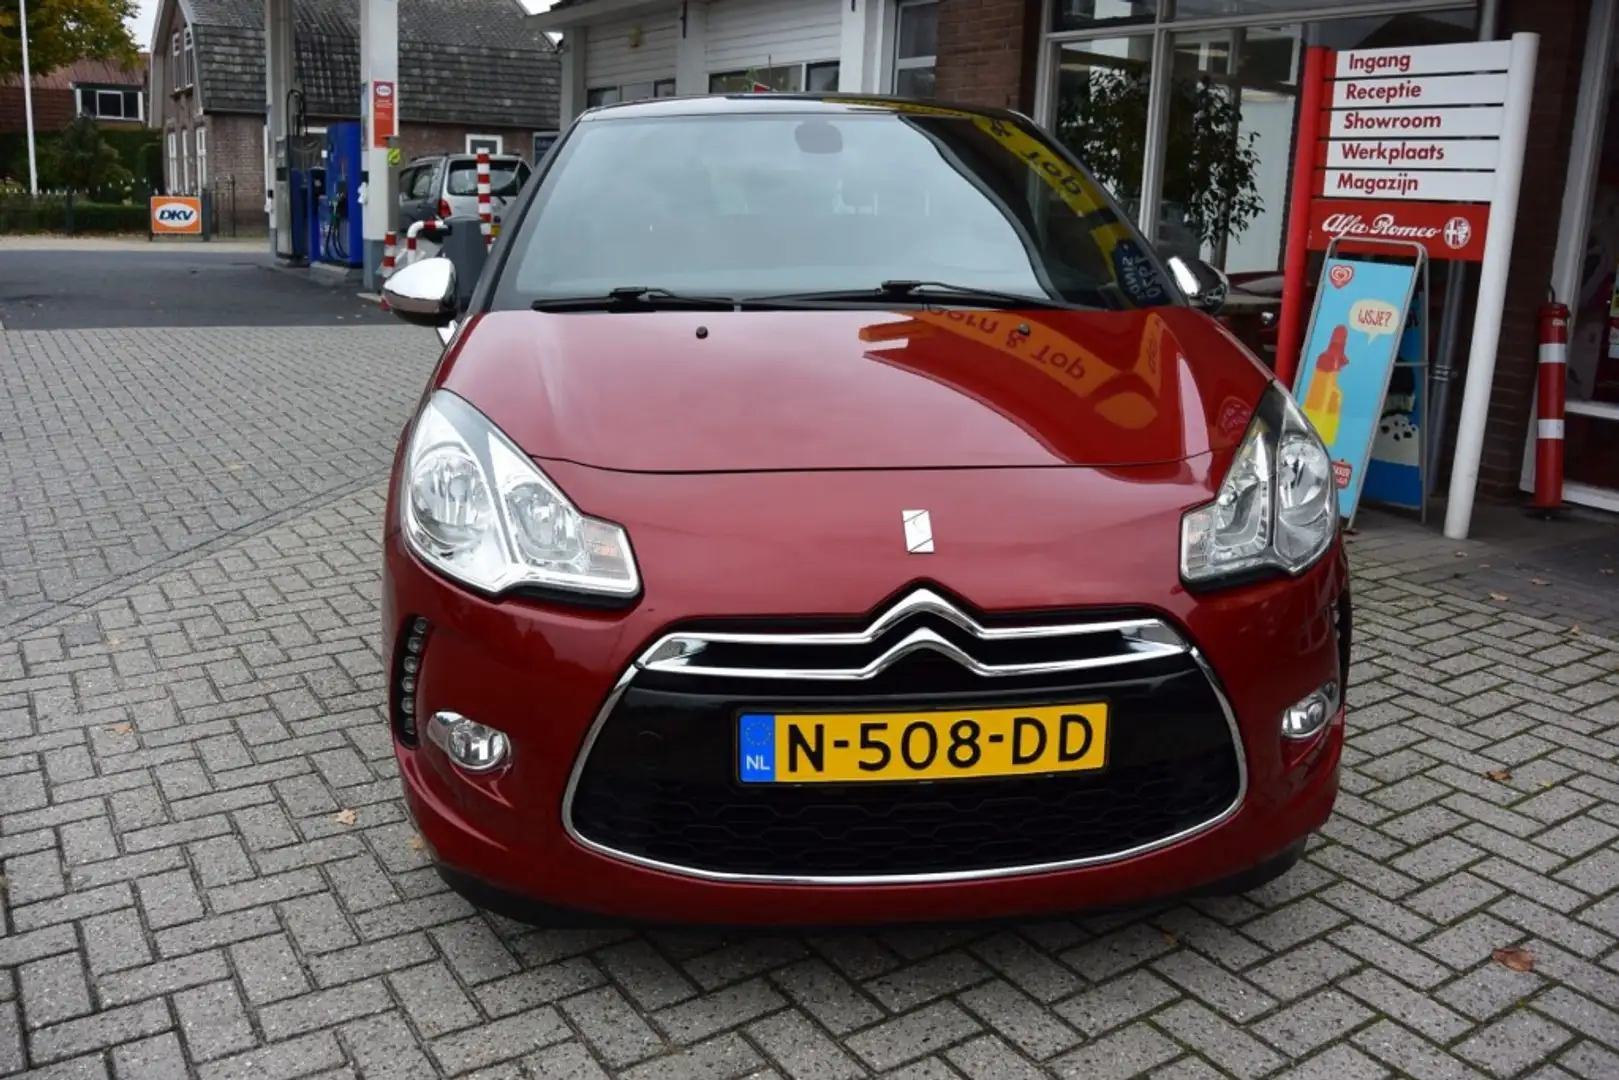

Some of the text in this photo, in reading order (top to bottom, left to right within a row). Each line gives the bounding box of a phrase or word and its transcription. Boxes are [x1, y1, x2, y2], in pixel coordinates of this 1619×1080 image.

[1348, 53, 1411, 72] Ingang
[1345, 82, 1422, 103] Receptie
[1343, 111, 1442, 130] Showroom
[1341, 142, 1445, 164] Werkplaats
[1337, 172, 1419, 195] Magazijn
[158, 209, 194, 221] DKV
[1321, 213, 1441, 239] Alfa Romeo
[788, 714, 1094, 773] N-508-DD
[746, 754, 770, 771] NL
